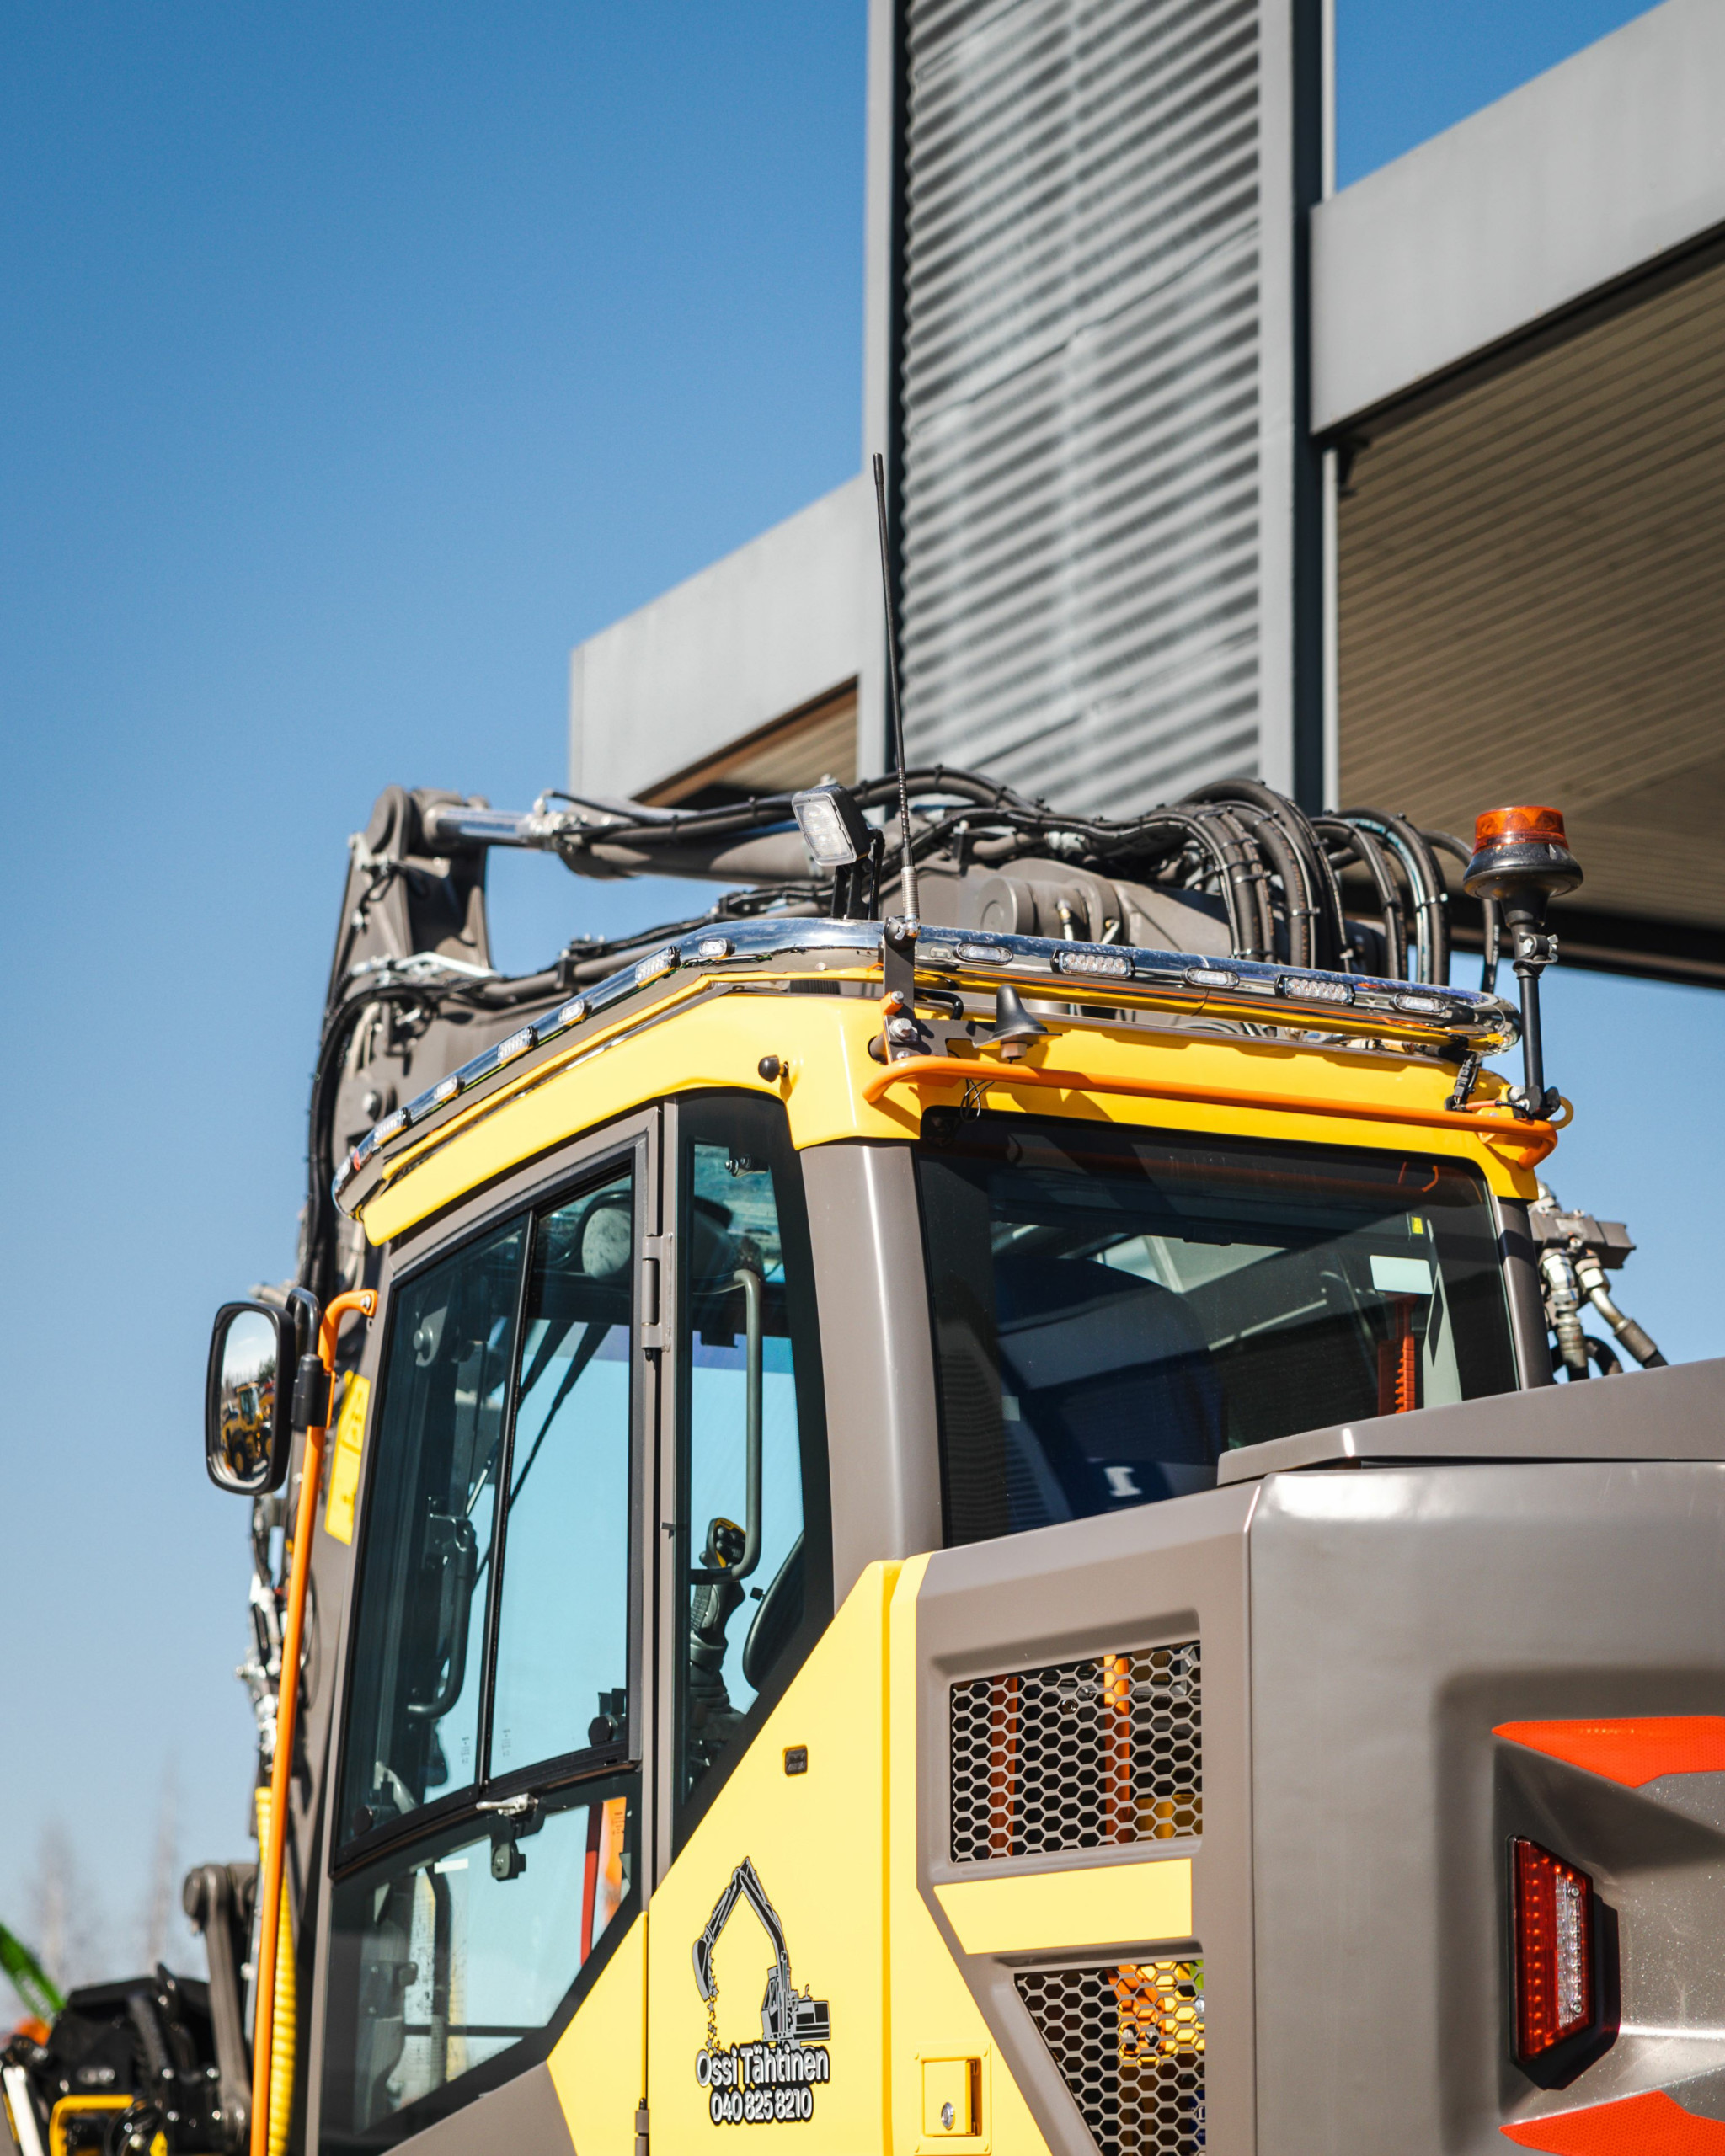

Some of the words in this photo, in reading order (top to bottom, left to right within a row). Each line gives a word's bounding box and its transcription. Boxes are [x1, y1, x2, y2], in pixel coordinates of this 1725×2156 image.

[696, 2046, 738, 2087] Ossi
[740, 2044, 830, 2084] Tähtinen
[710, 2089, 743, 2123] 040
[744, 2088, 773, 2121] 825
[774, 2086, 813, 2120] 8210
